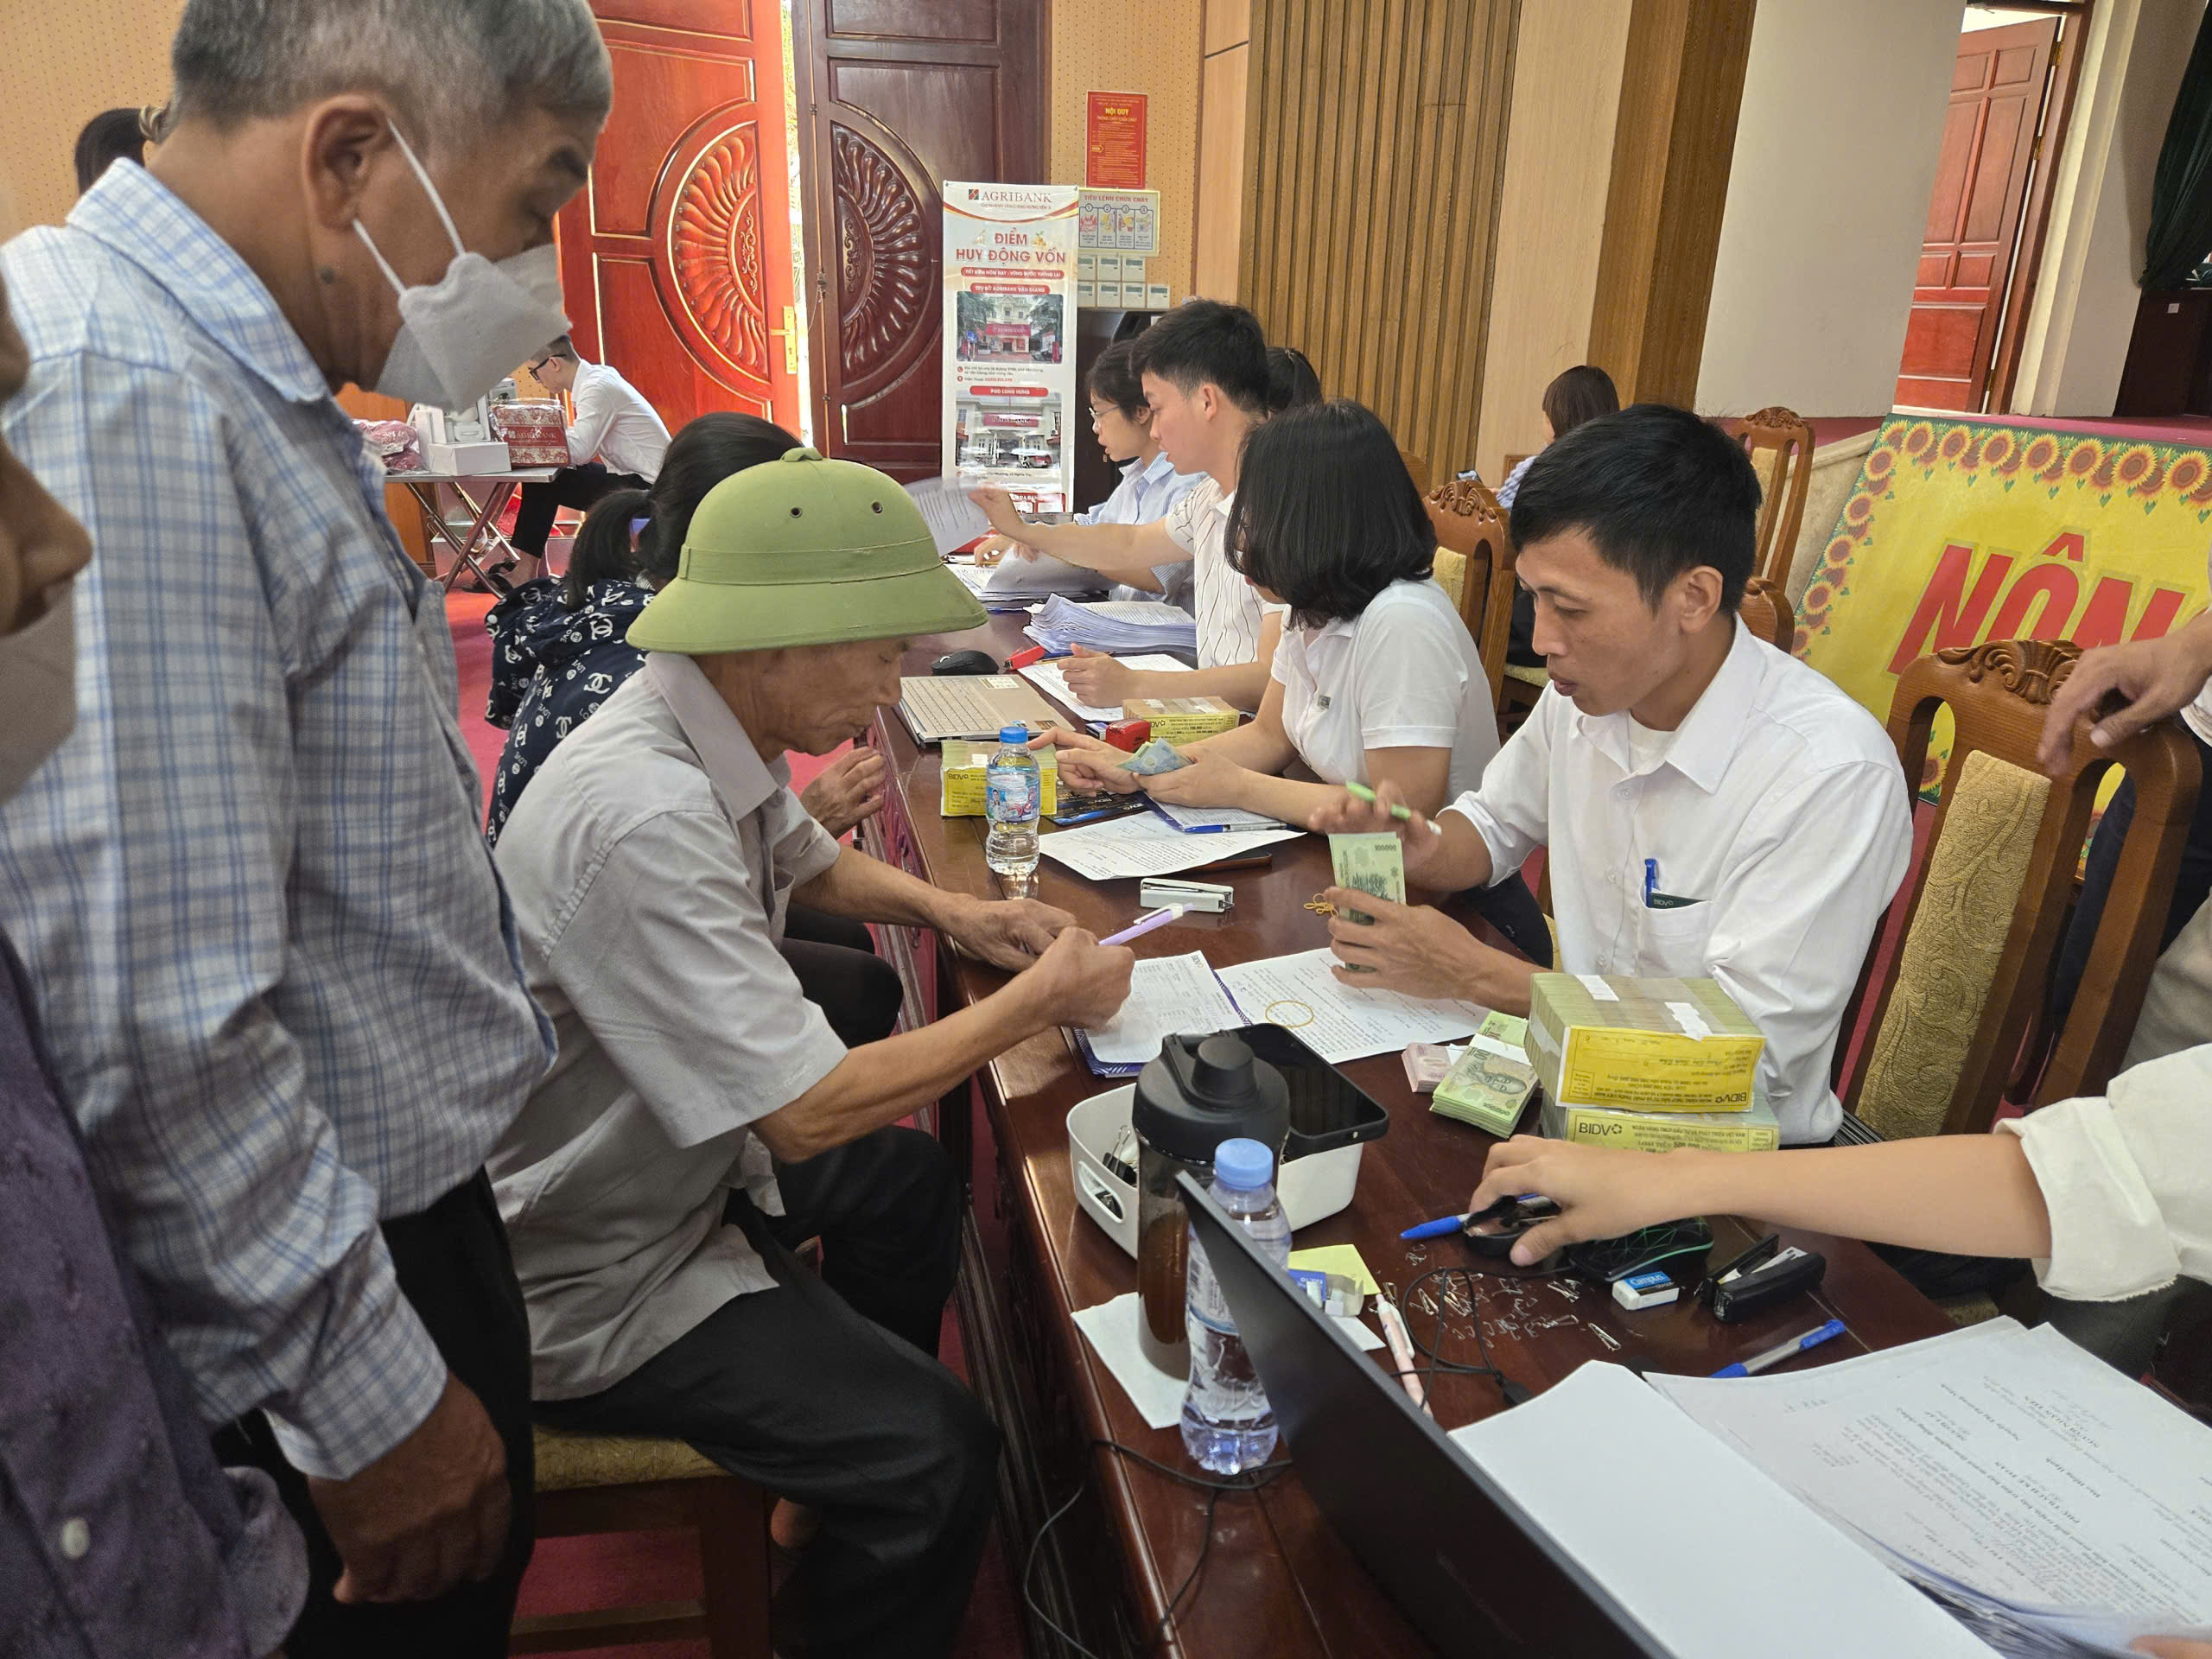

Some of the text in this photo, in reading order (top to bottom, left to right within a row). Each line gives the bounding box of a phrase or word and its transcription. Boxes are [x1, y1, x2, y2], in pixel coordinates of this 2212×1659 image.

[982, 191, 1052, 203] AGRIBANK
[995, 227, 1027, 245] ĐIỂM
[956, 246, 1065, 264] HUY ĐỘNG VỐN
[1726, 1092, 1746, 1103] BIDV
[1579, 1122, 1611, 1135] BIDV
